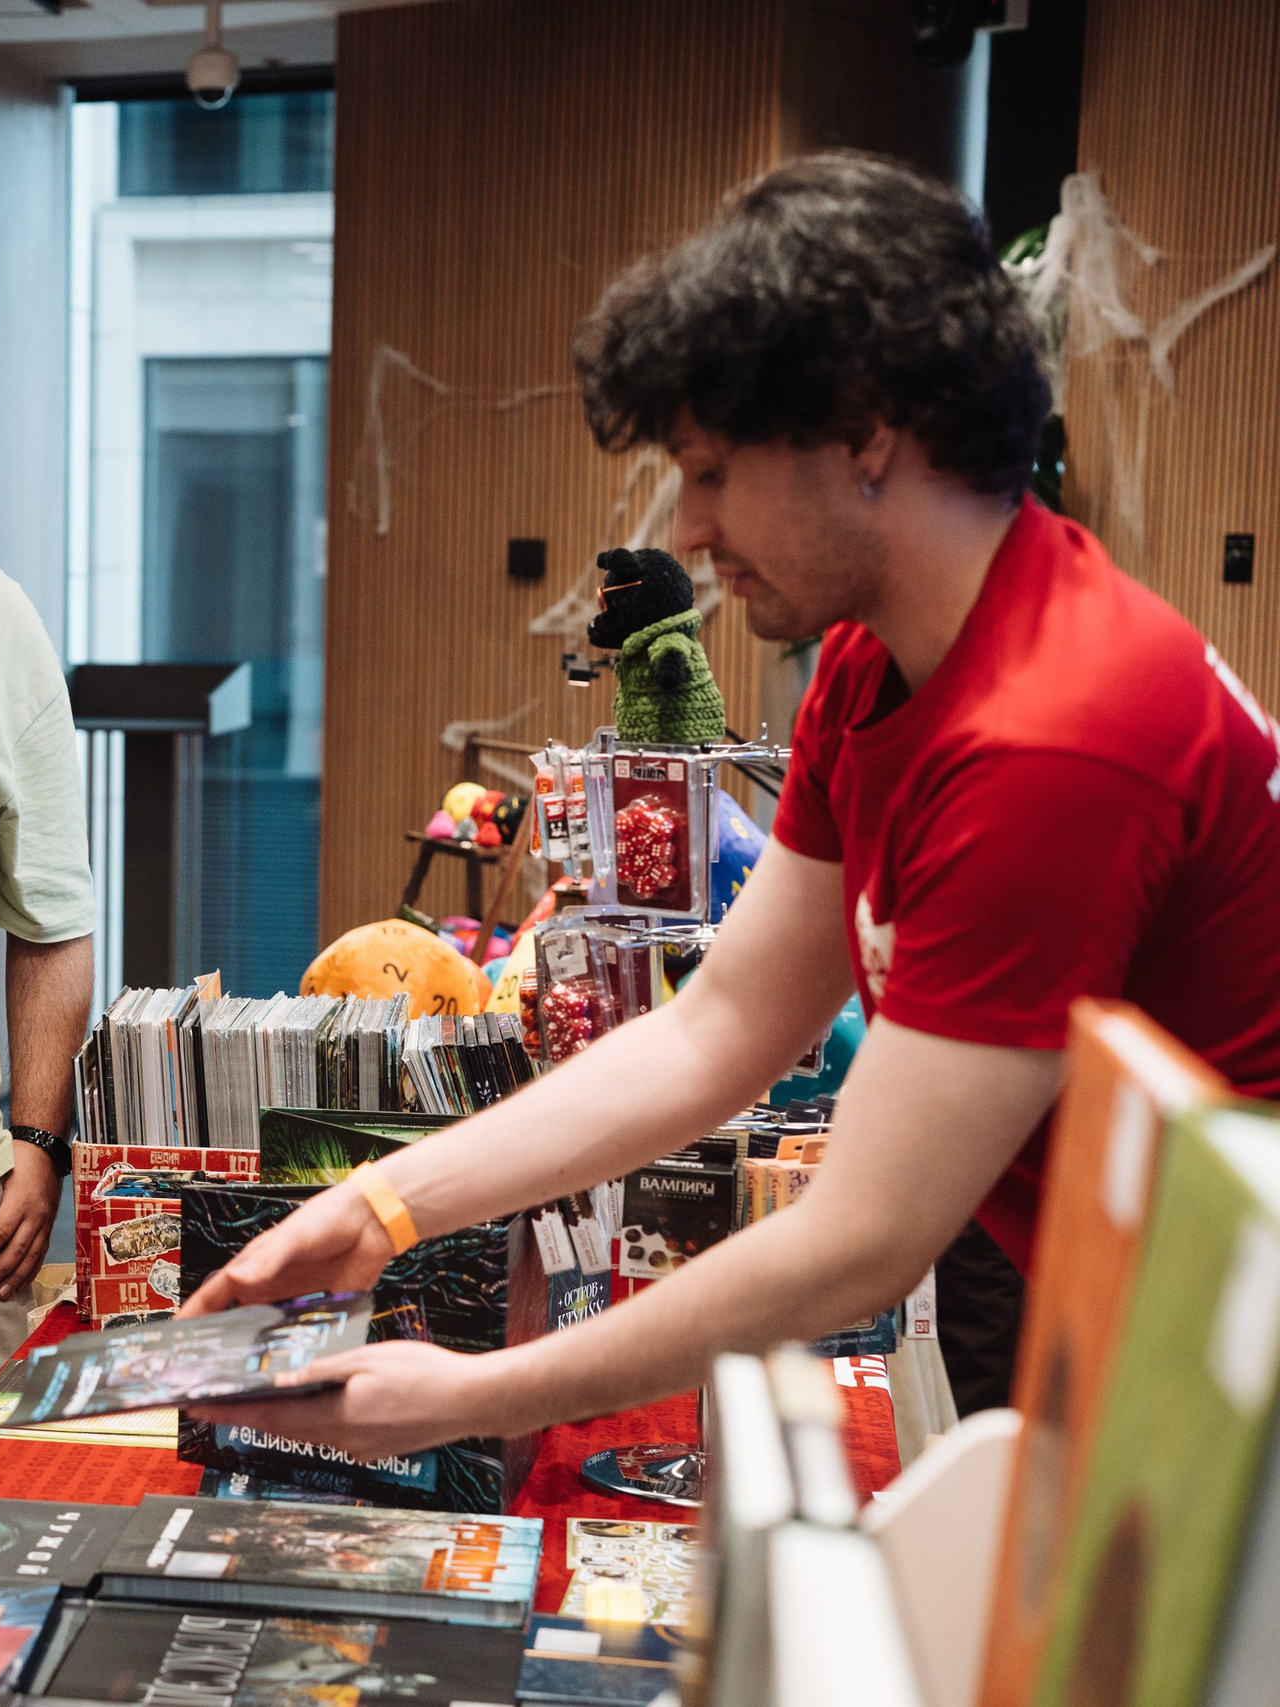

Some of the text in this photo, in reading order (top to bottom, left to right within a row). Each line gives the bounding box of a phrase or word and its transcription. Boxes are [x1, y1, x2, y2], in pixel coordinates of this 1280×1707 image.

[639, 1176, 716, 1196] ВАМПИРЫ
[119, 1282, 149, 1304] 101
[564, 1281, 598, 1307] ОСТРОВ
[319, 1443, 422, 1477] СИСМЫ#
